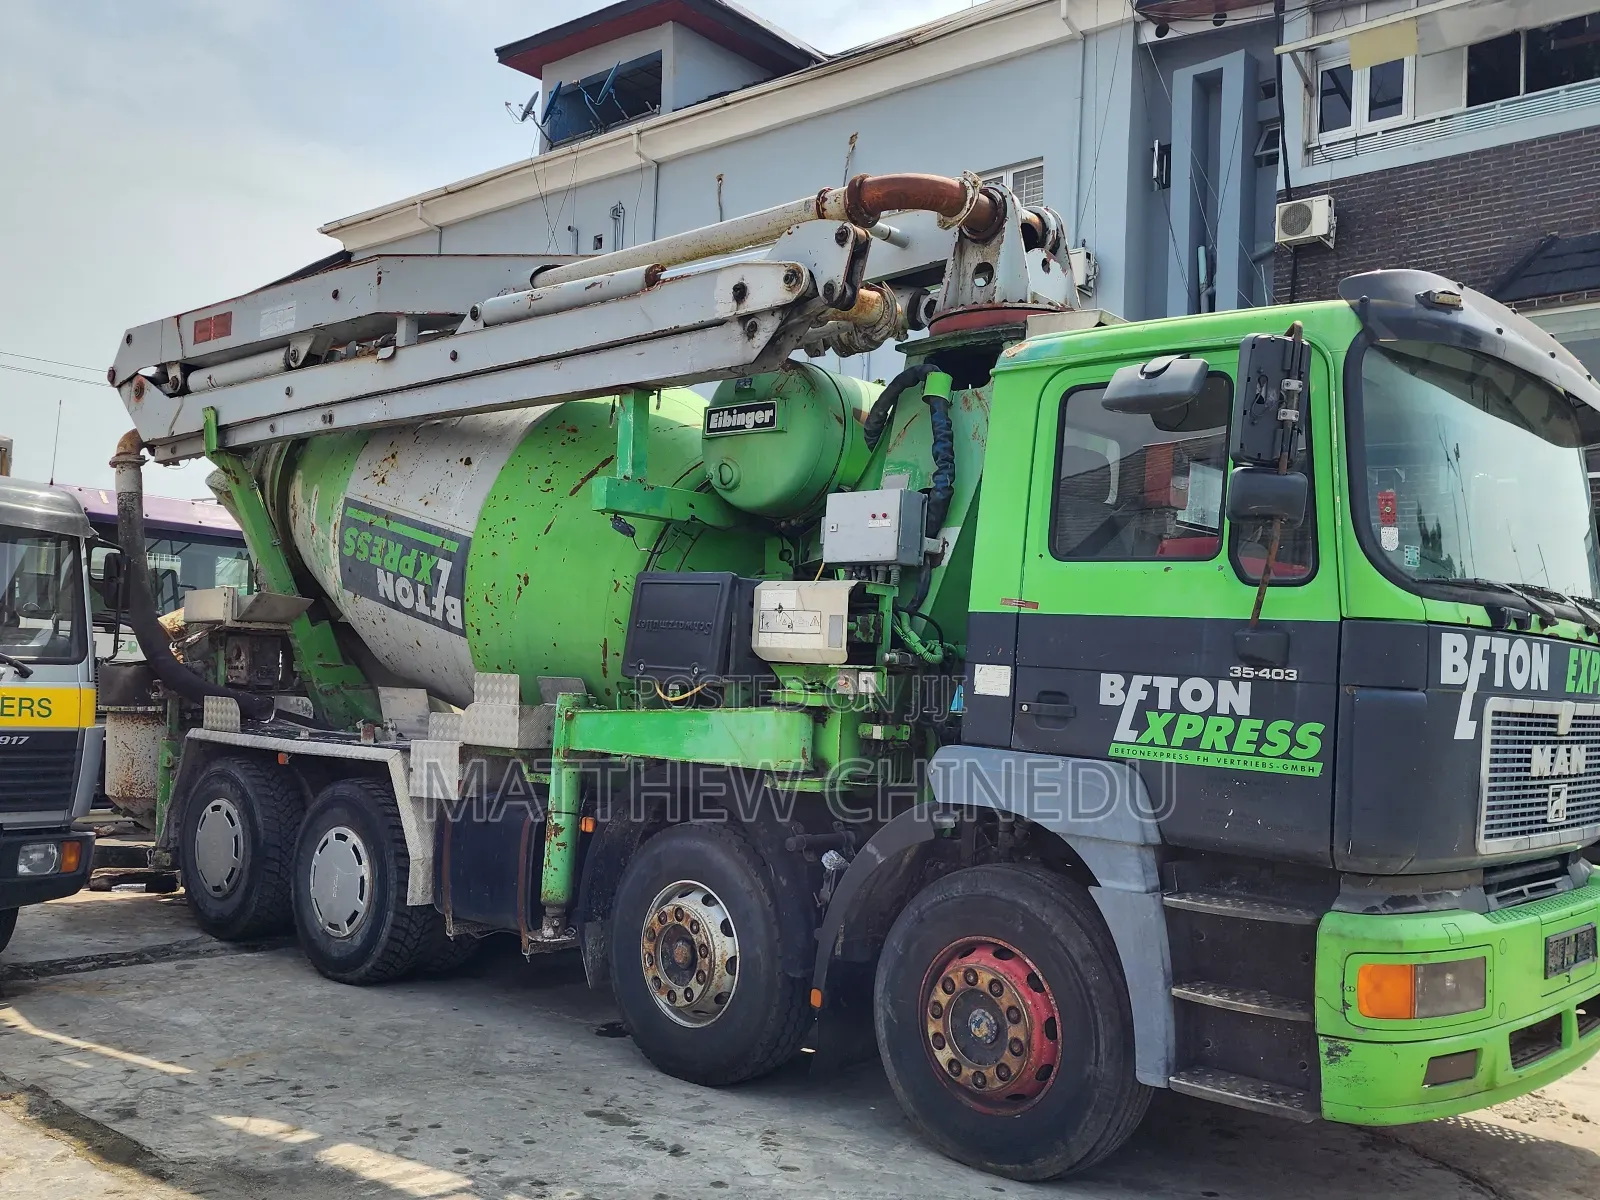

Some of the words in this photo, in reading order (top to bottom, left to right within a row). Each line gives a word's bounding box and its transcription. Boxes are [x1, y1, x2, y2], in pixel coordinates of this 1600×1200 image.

[709, 409, 774, 429] Eibinger
[1565, 647, 1600, 695] EXP
[0, 696, 52, 718] ERS
[1114, 747, 1190, 762] BETONEXPRESS
[1530, 745, 1587, 777] MAN
